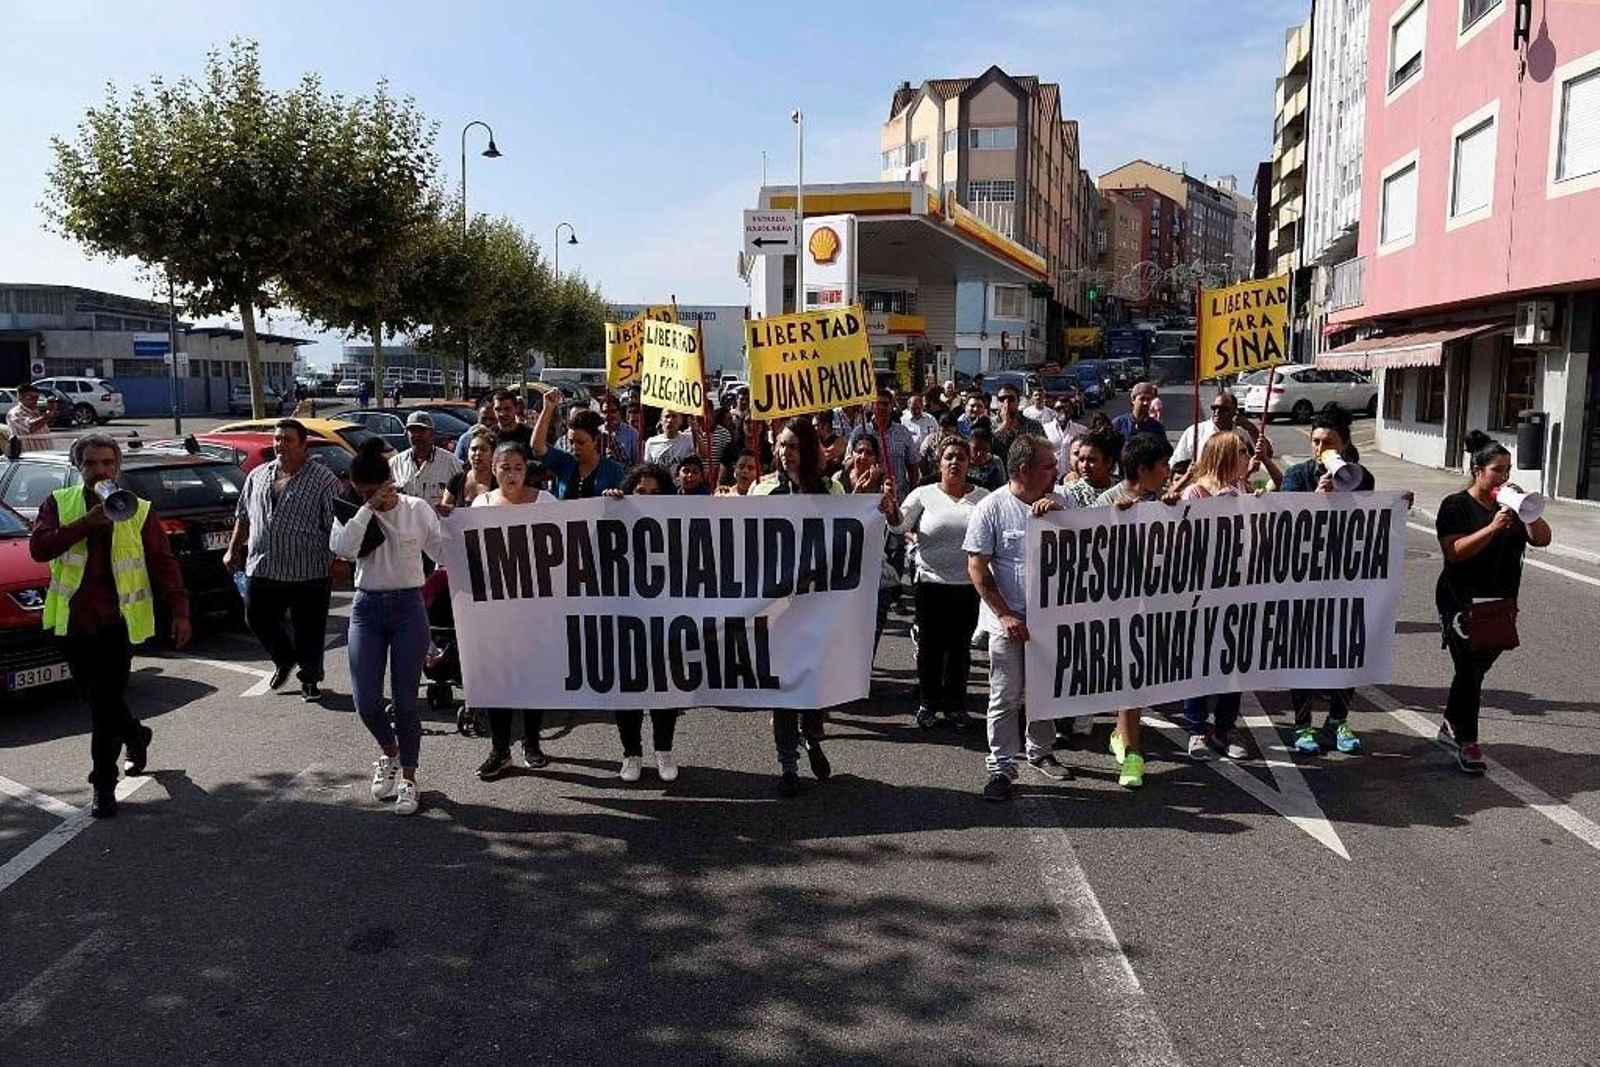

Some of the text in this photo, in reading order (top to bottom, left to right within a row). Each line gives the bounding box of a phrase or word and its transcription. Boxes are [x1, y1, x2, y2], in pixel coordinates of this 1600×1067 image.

[1212, 287, 1287, 316] LIBERTAD
[646, 325, 697, 353] LIBERTAD
[752, 314, 860, 348] LIBERTAD
[1229, 313, 1273, 333] PARA
[617, 351, 644, 381] SA
[660, 356, 679, 370] PARA
[782, 351, 820, 362] PARA
[643, 373, 702, 408] OLEGARIO
[754, 358, 871, 412] JUAN PAULO
[464, 517, 865, 602] IMPARCIALIDAD
[1039, 506, 1392, 607] PRESUNCIÓN DE INOCENCIA
[565, 615, 780, 693] JUDICIAL
[1054, 595, 1366, 698] PARA SINAÍ Y SU FAMILIA
[17, 668, 51, 686] 3310
